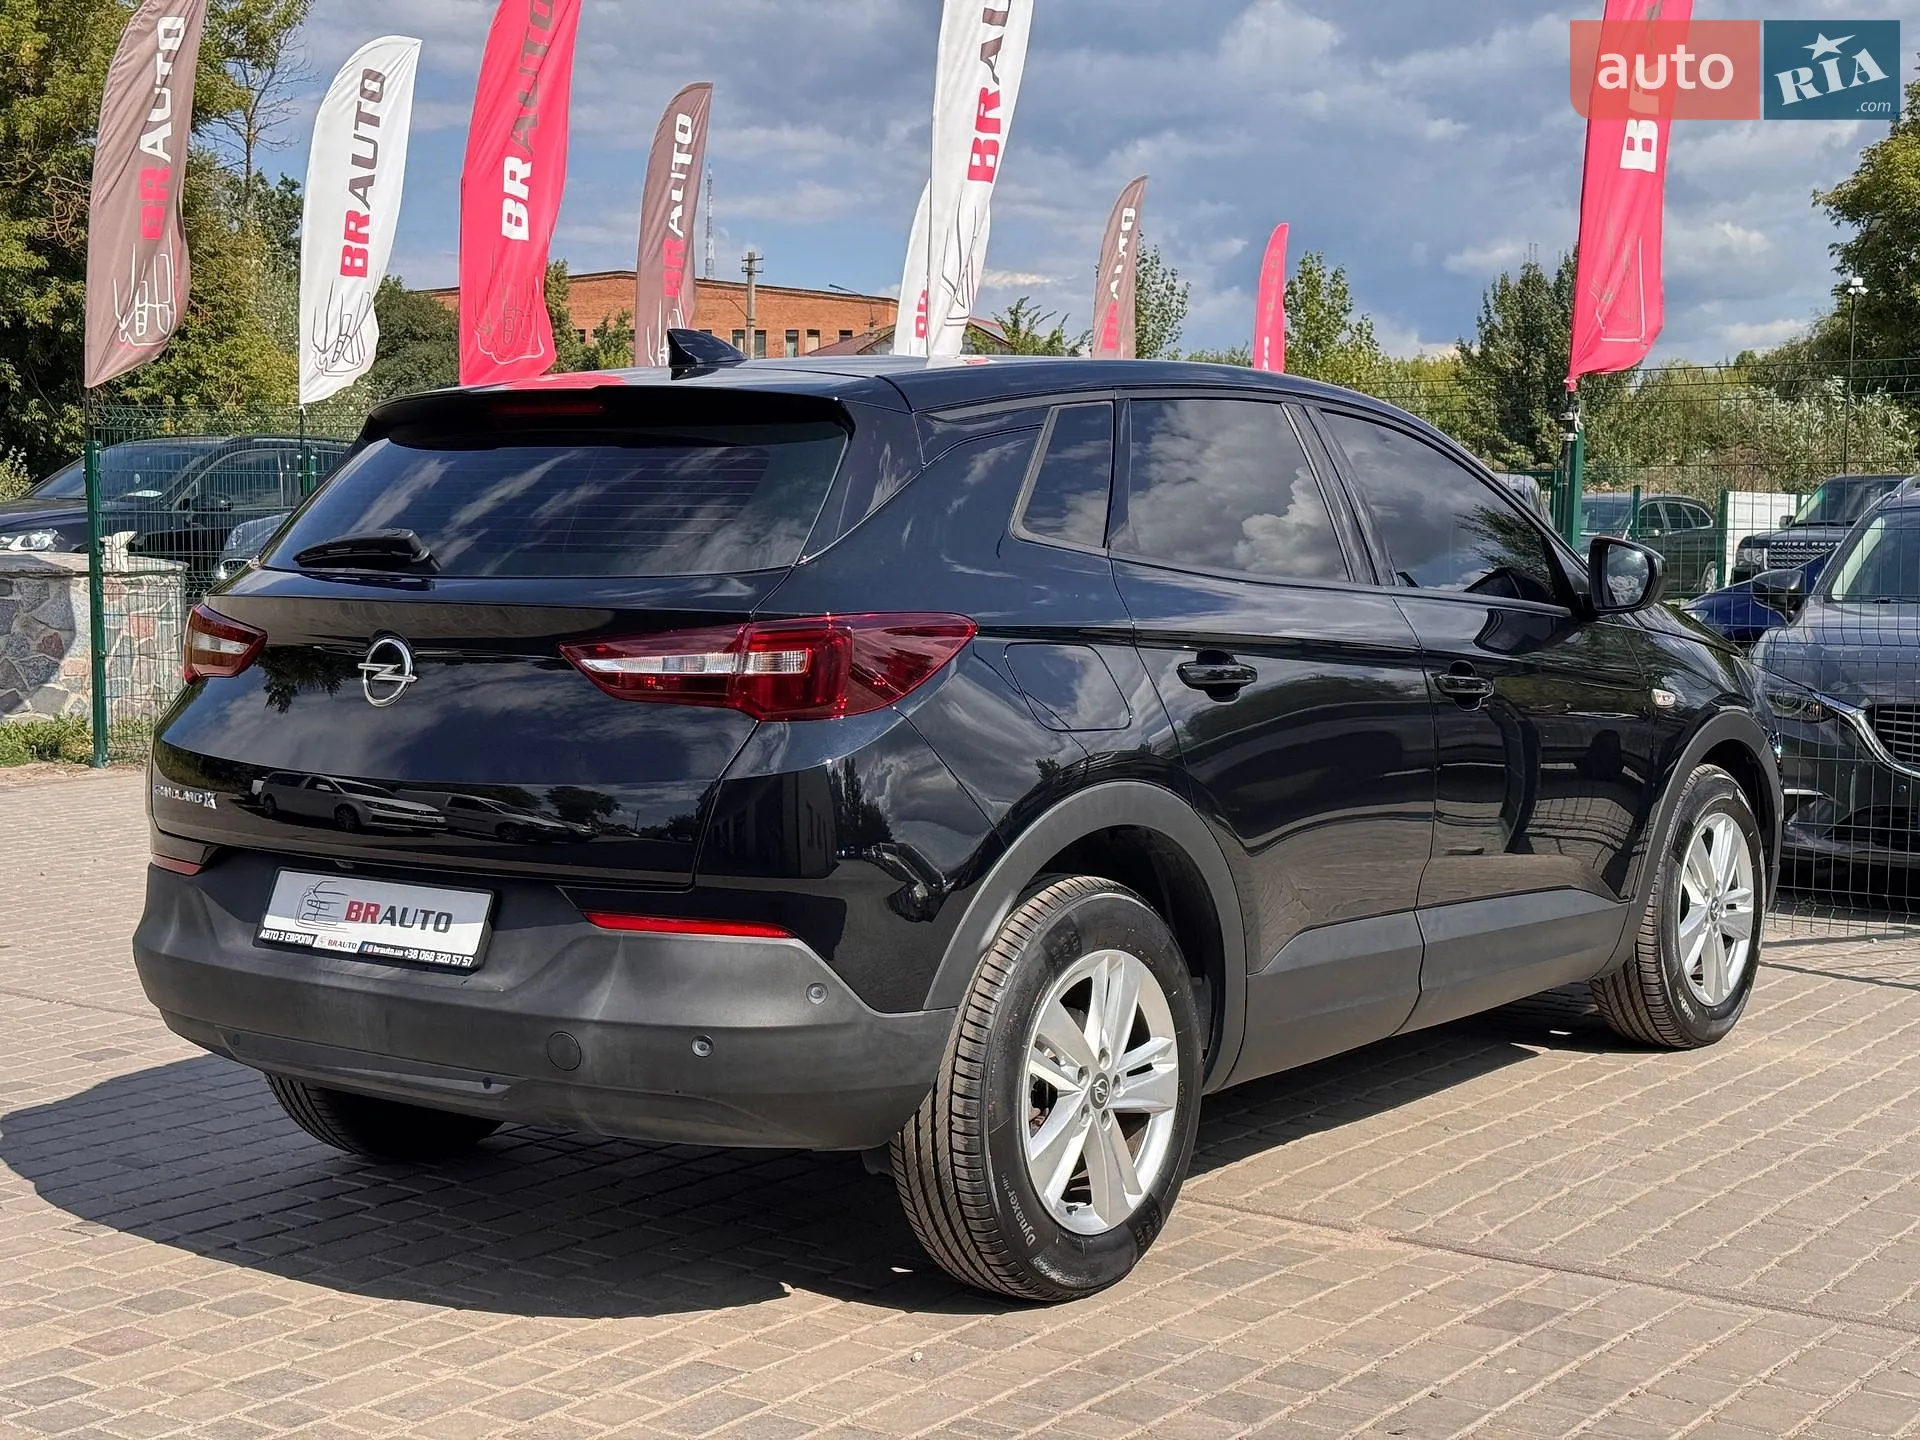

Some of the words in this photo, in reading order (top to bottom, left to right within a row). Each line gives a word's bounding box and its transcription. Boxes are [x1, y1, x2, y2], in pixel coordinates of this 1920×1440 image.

[138, 15, 186, 241] BRAUTO
[340, 68, 386, 278] BRAUTO
[259, 929, 280, 939] АВТО
[344, 900, 453, 934] BRAUTO
[327, 938, 358, 950] BRAUTO
[404, 948, 419, 959] +38
[419, 950, 435, 962] 068
[435, 953, 451, 964] 320
[451, 955, 462, 966] 57
[462, 956, 474, 967] 57
[1008, 1190, 1036, 1247] Dynaxer
